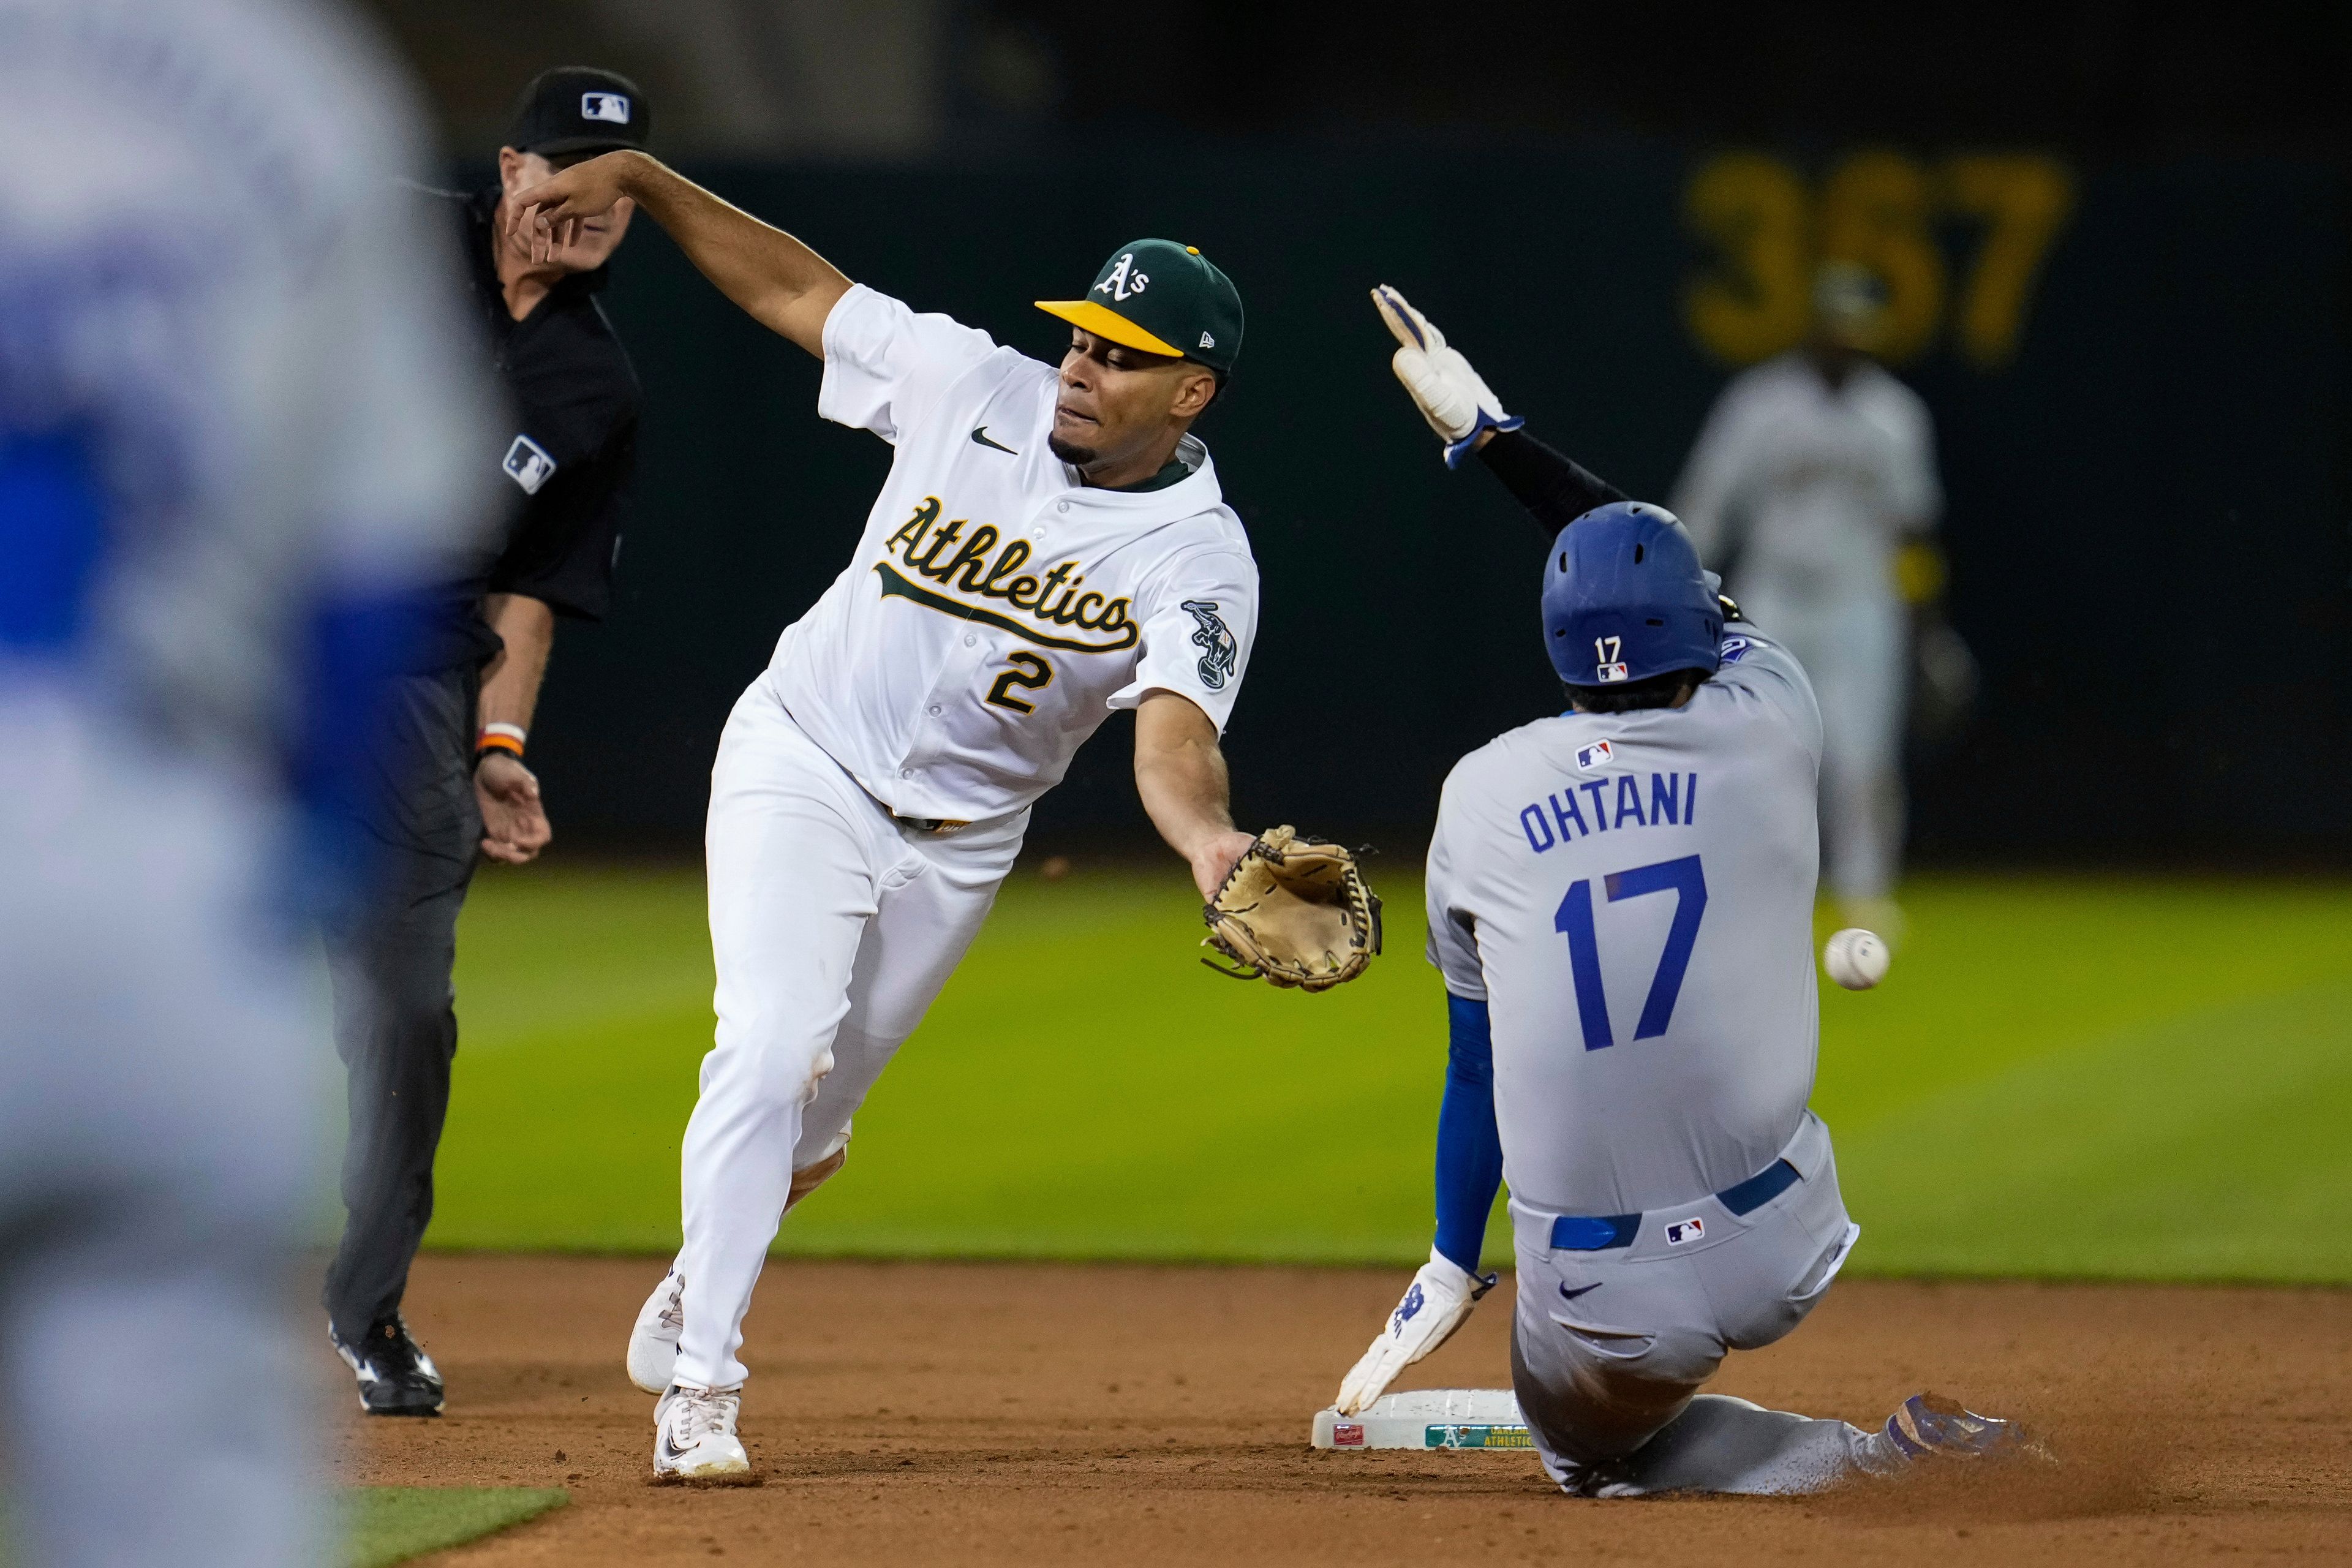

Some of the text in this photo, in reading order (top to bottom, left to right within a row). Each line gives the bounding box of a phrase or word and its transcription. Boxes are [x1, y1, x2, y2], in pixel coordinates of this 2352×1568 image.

[1094, 253, 1149, 301] A's
[1687, 153, 2074, 371] 367
[883, 496, 1133, 631] Athletics
[984, 650, 1054, 716] 2
[1595, 636, 1621, 663] 17
[1520, 772, 1697, 853] OHTANI
[1555, 854, 1708, 1051] 17
[1484, 1436, 1534, 1447] ATHLETIC
